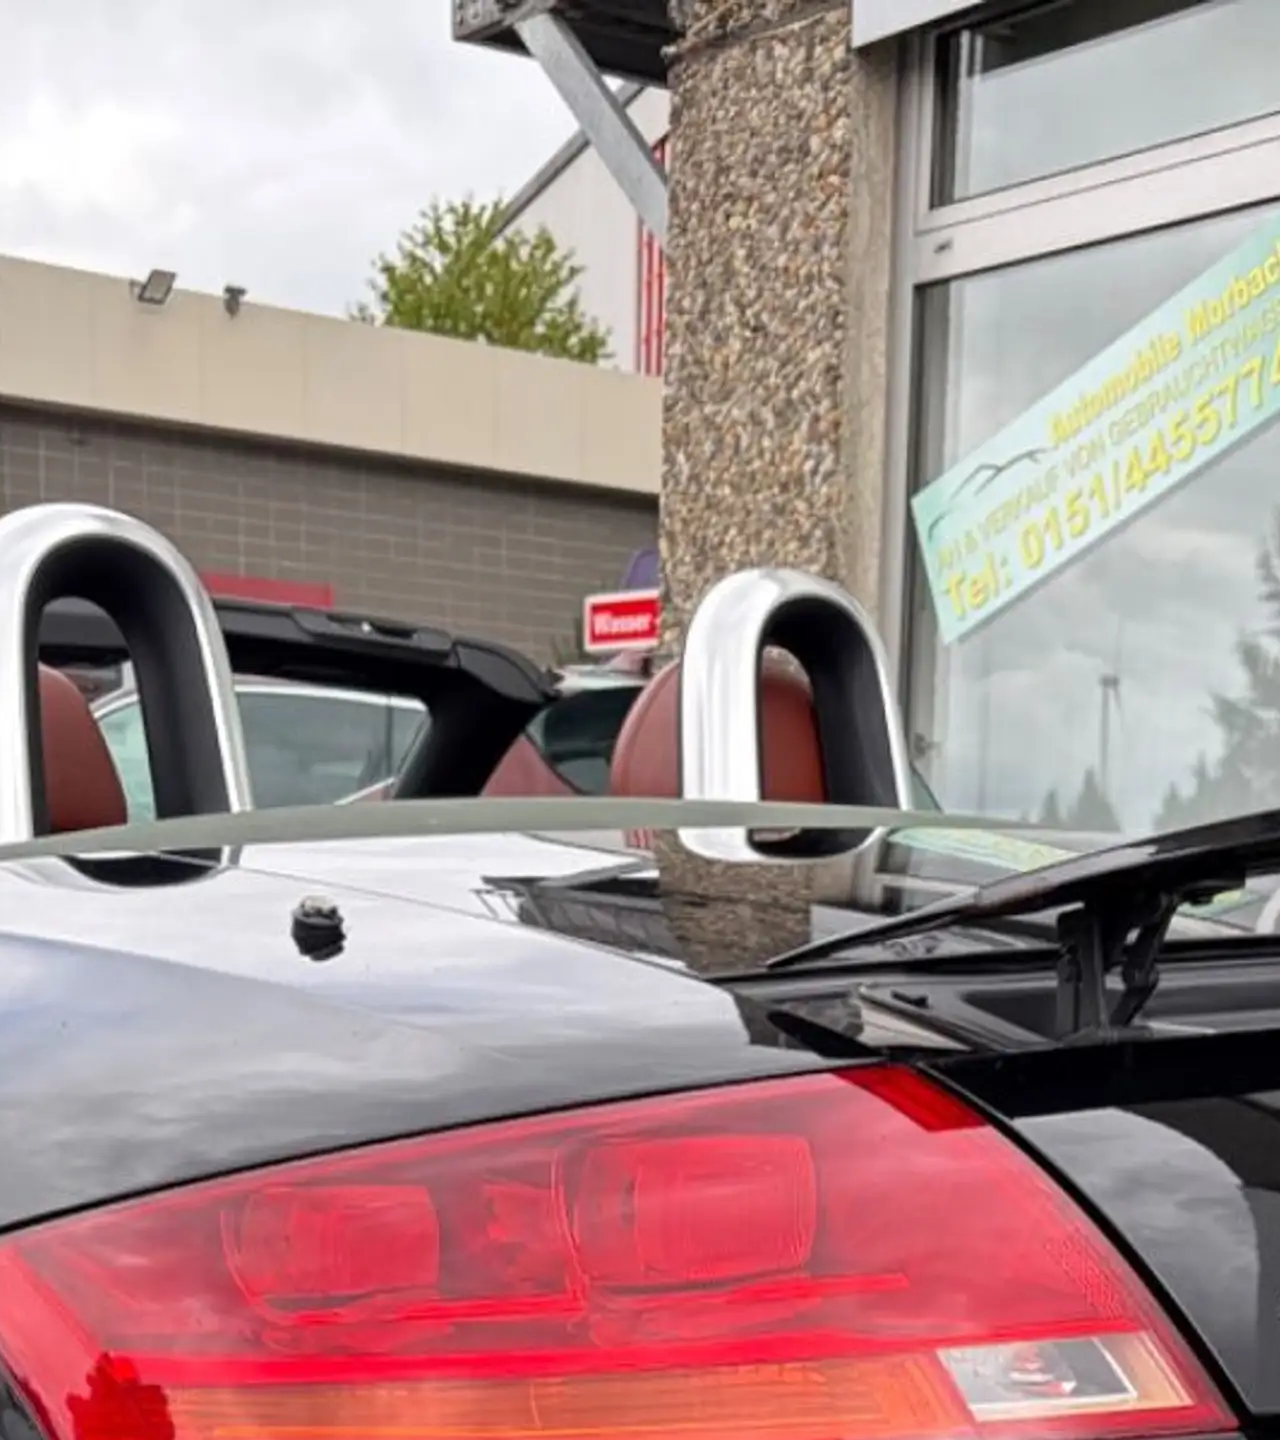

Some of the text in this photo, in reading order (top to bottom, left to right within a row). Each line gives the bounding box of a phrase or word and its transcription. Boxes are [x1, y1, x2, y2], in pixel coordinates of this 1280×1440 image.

[1048, 335, 1181, 447] Automobile
[1065, 434, 1107, 477] VON
[944, 552, 1013, 620] Tel:
